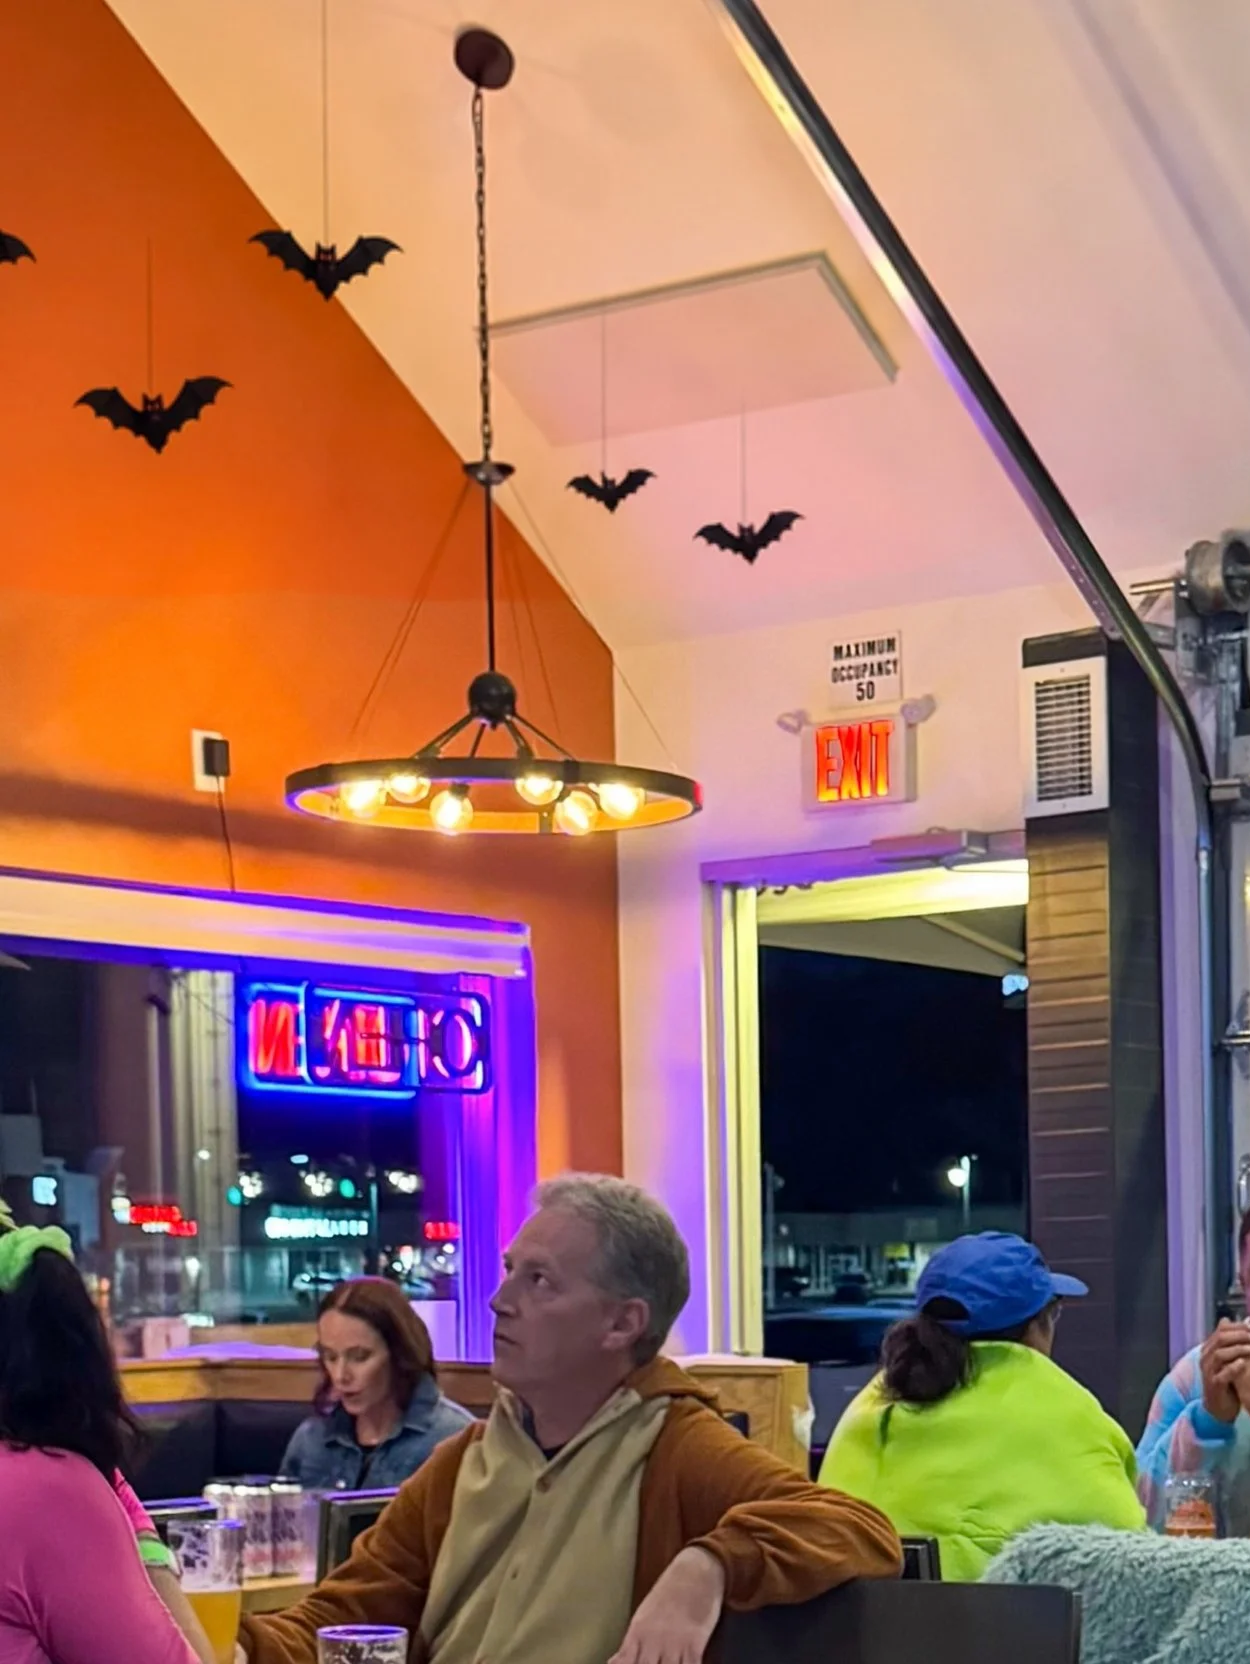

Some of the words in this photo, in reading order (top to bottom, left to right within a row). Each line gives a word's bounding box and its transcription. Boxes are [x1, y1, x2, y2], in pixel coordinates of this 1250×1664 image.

[834, 637, 896, 661] MAXIMUM
[831, 659, 898, 684] OCCUPANCY
[856, 681, 875, 702] 50
[816, 720, 893, 803] EXIT
